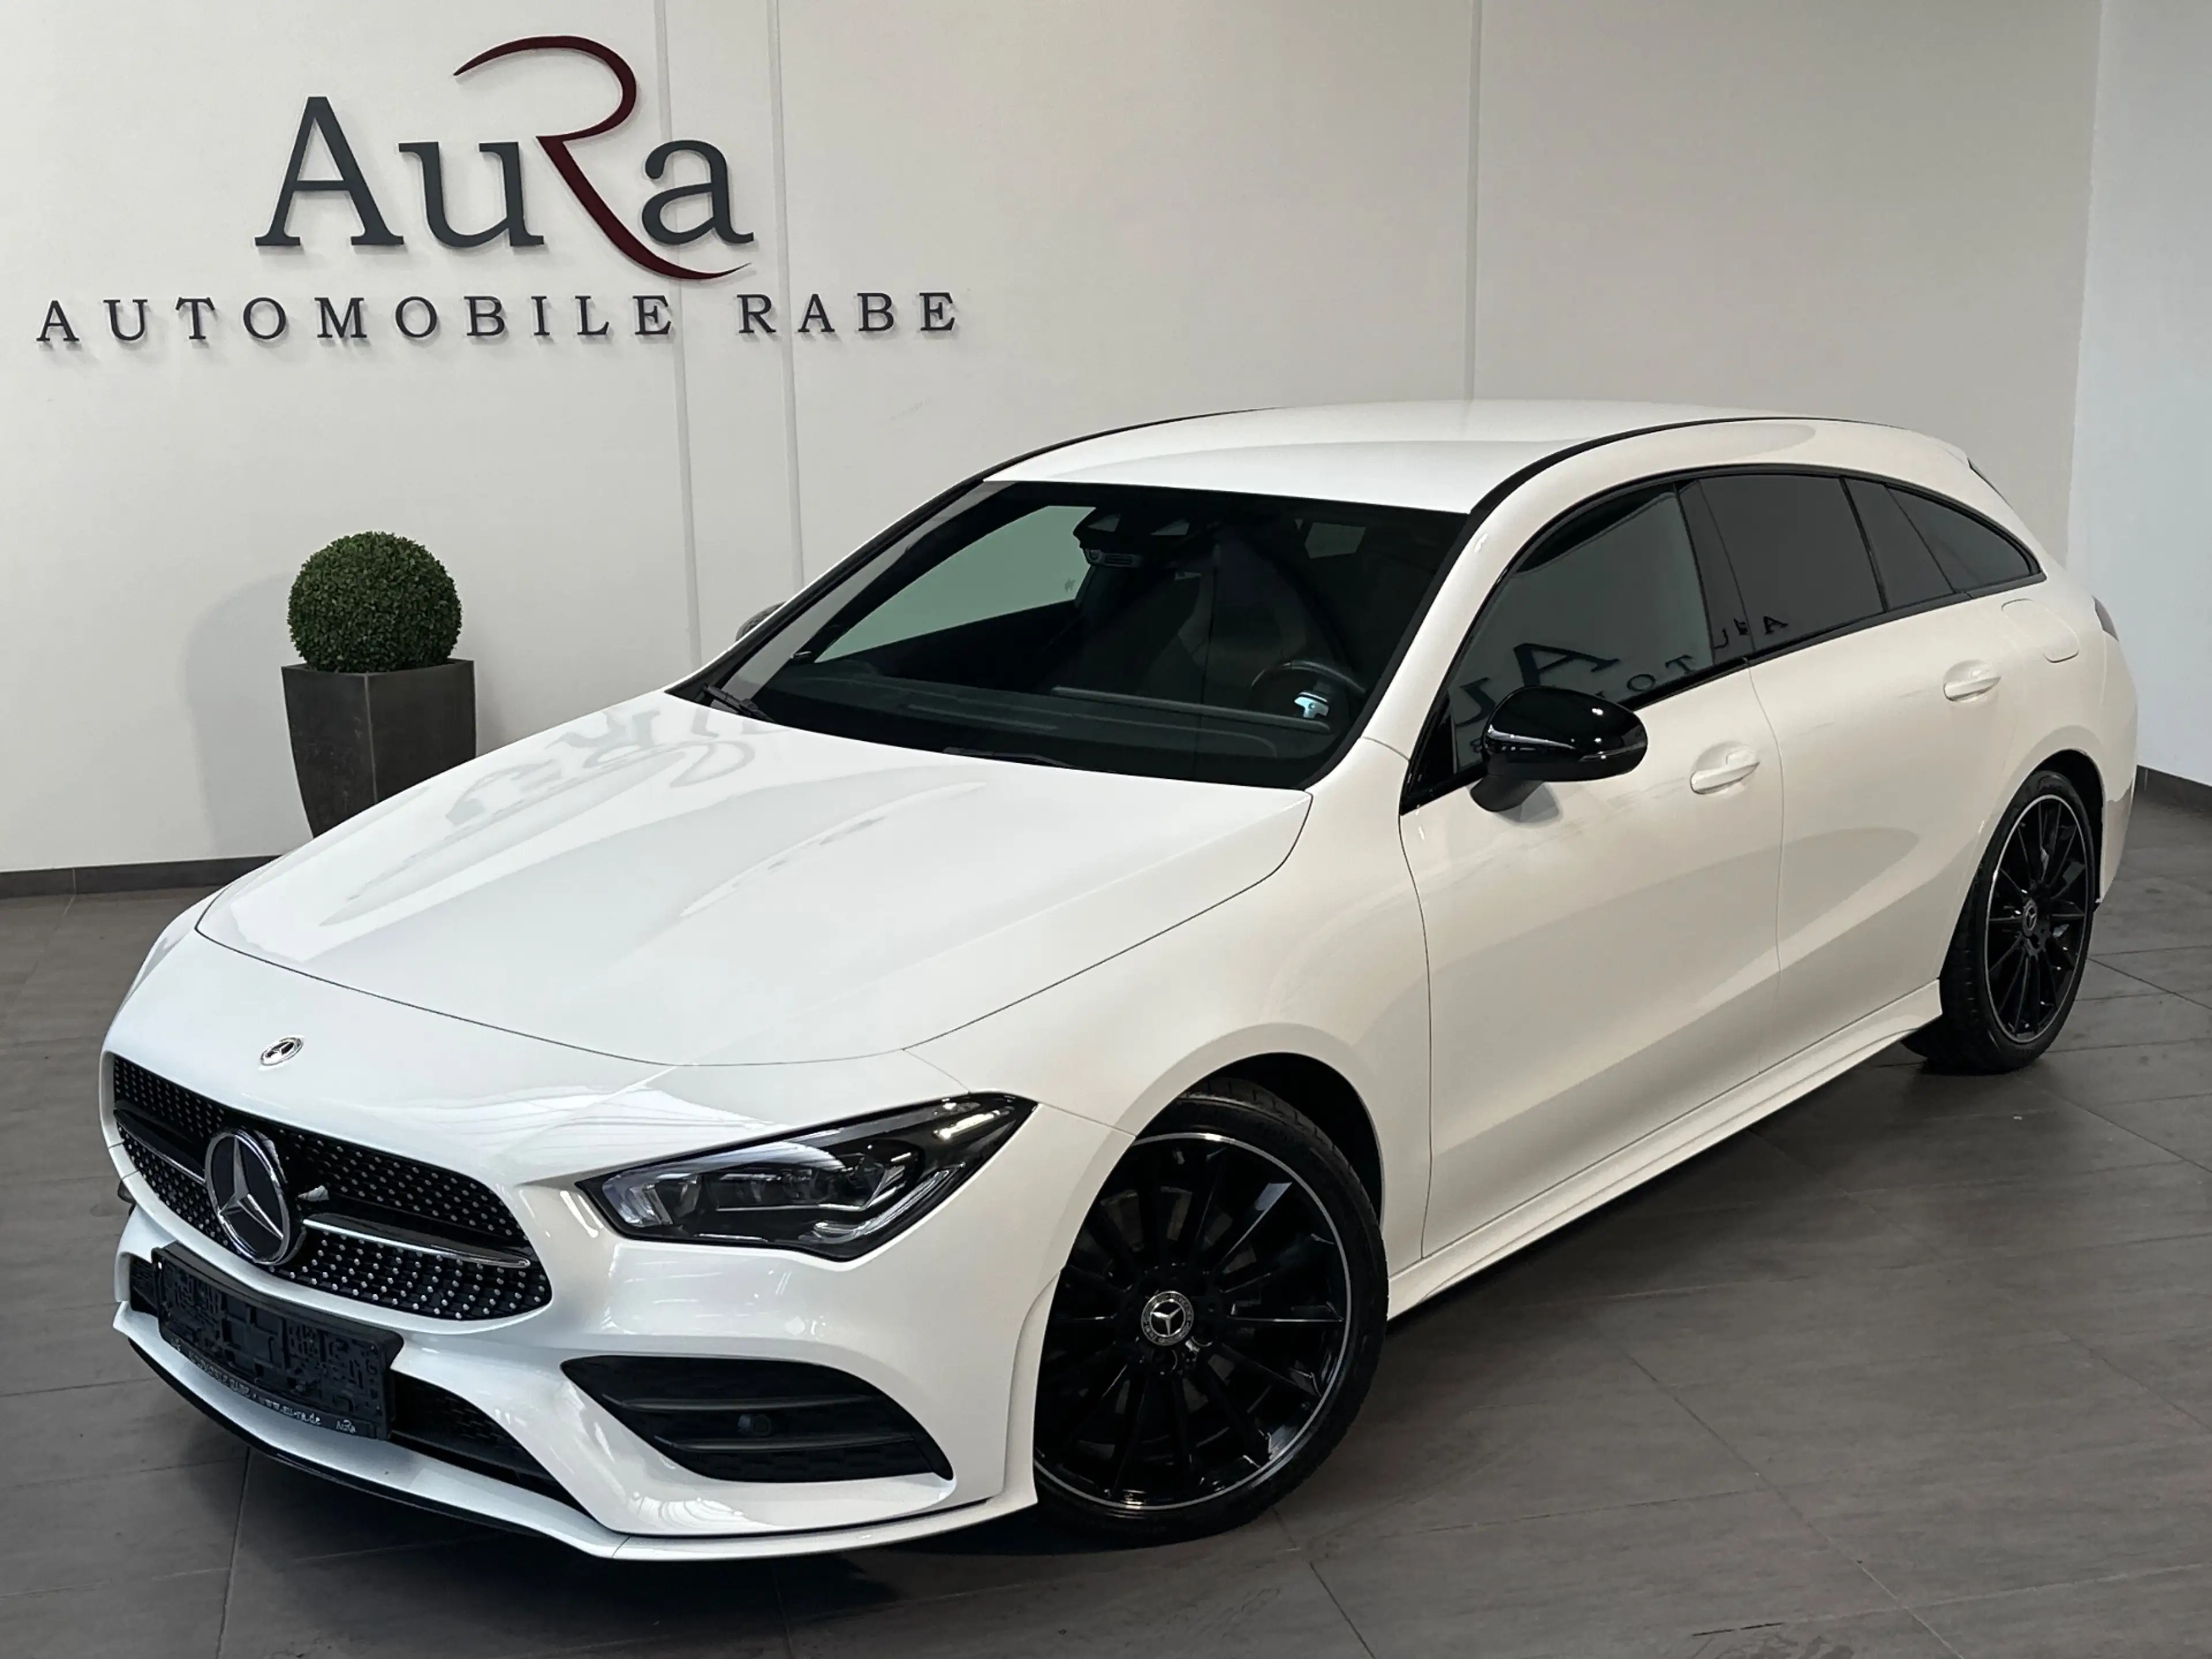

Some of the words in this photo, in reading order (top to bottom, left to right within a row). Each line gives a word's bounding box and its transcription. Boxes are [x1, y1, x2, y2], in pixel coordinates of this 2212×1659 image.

[255, 36, 754, 282] AuRa
[36, 294, 672, 344] AUTOMOBILE
[737, 292, 957, 335] RABE
